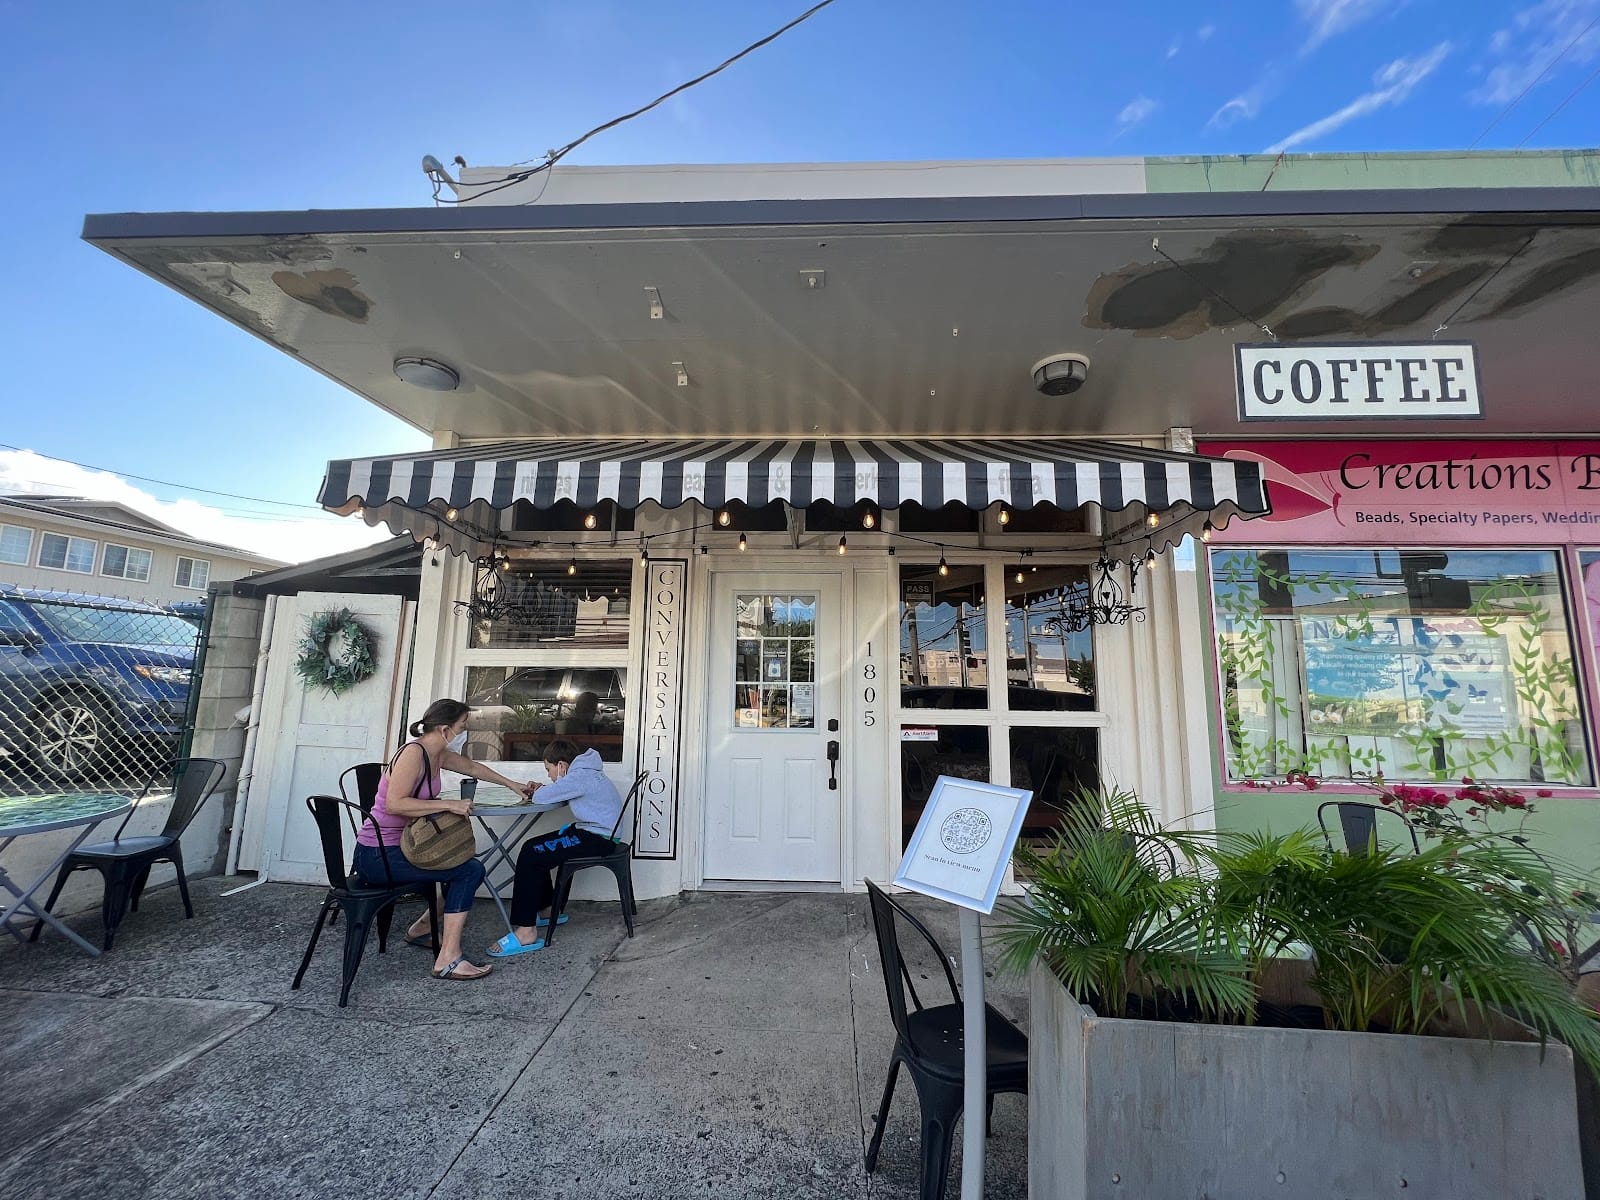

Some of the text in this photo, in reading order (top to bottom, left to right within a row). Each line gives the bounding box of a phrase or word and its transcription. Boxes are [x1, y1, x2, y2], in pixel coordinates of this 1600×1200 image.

[1253, 358, 1467, 405] COFFEE
[774, 465, 786, 493] &
[1339, 453, 1552, 490] Creations
[1355, 511, 1404, 525] Beads,
[1409, 511, 1478, 527] Specialty
[1483, 511, 1538, 527] Papers,
[906, 585, 930, 593] PASS
[863, 640, 876, 727] 1805
[649, 569, 675, 840] CONVERSATIONS
